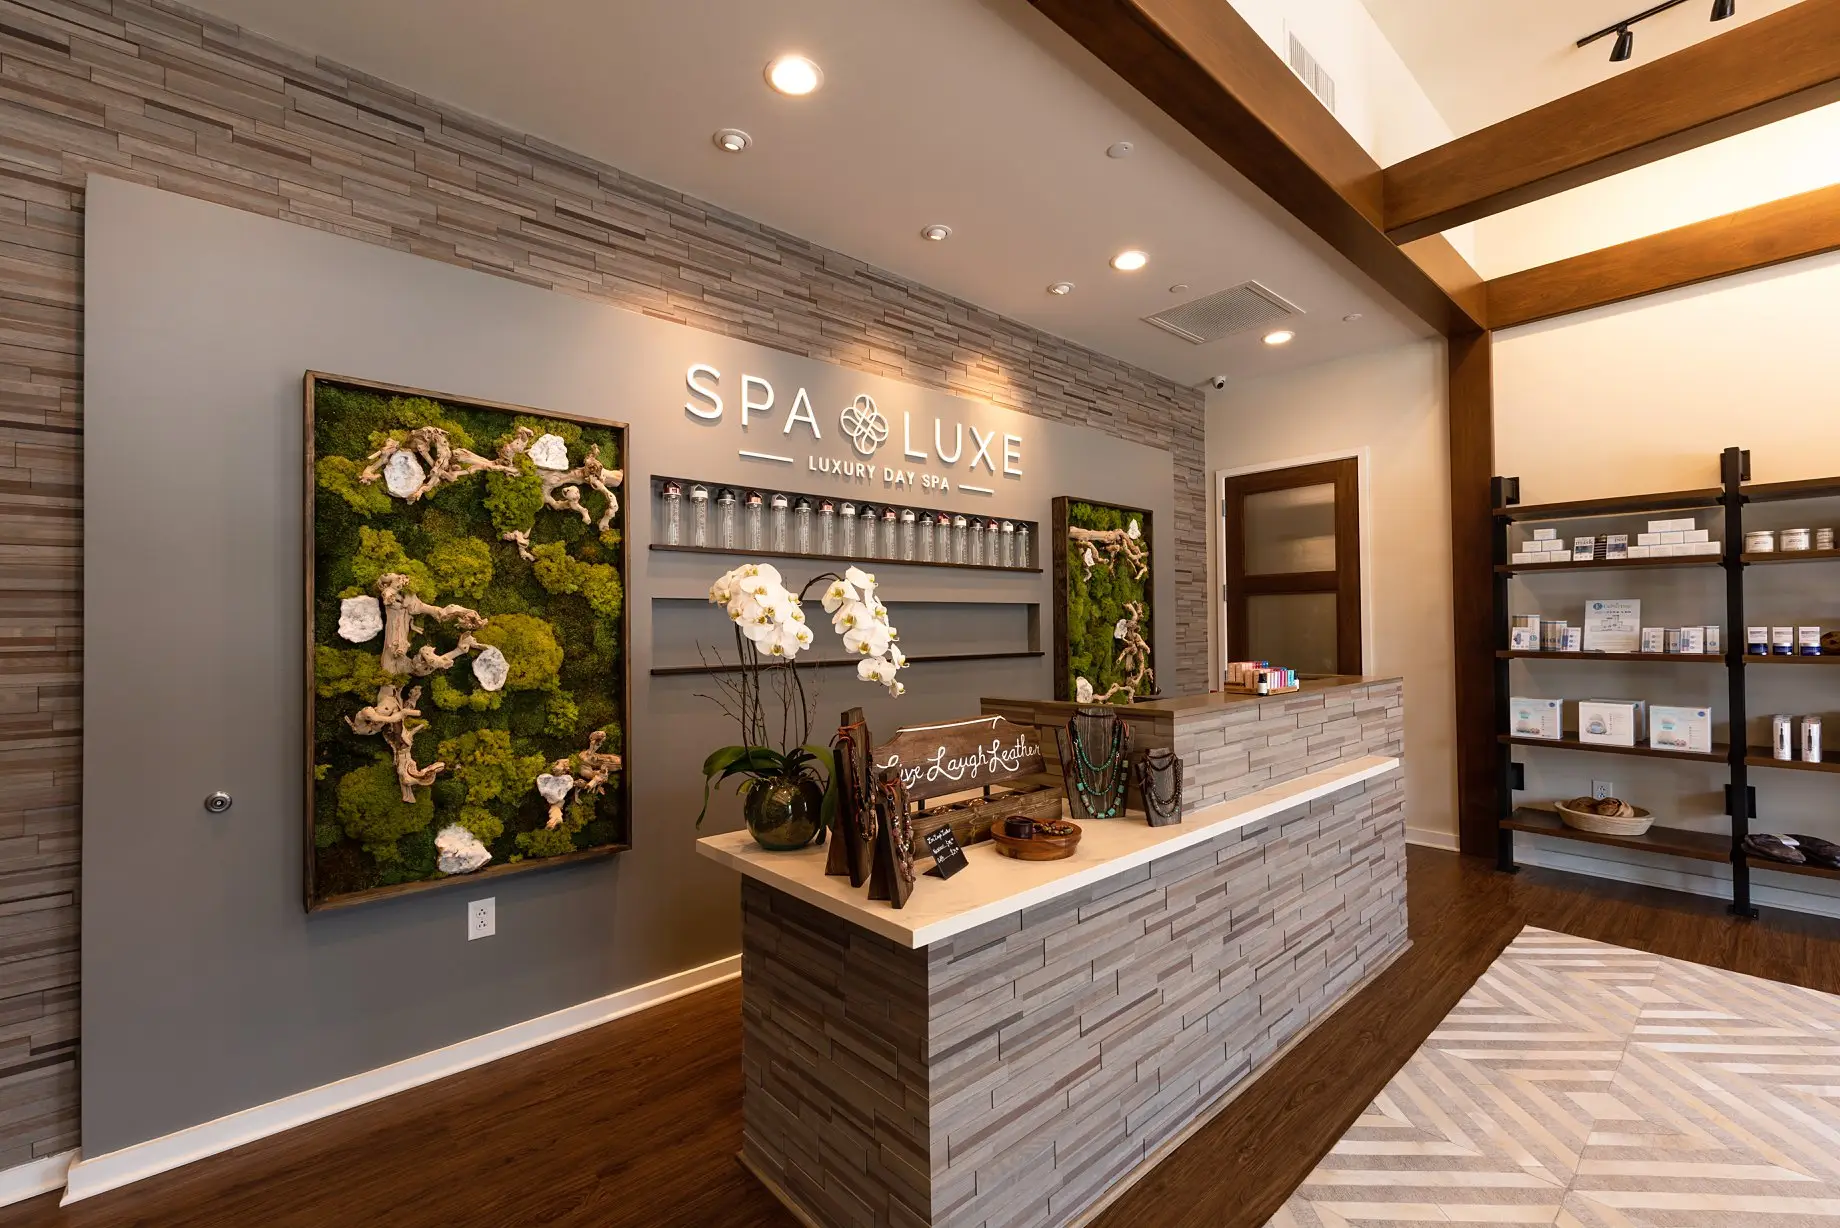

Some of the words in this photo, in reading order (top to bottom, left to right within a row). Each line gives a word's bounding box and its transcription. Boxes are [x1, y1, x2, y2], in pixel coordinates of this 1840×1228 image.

[684, 363, 821, 439] SPA
[903, 410, 1023, 476] LUXE
[808, 455, 876, 479] LUXURY
[883, 468, 915, 486] DAY
[921, 475, 950, 491] SPA
[926, 746, 988, 781] Laugh
[987, 733, 1041, 773] Leather
